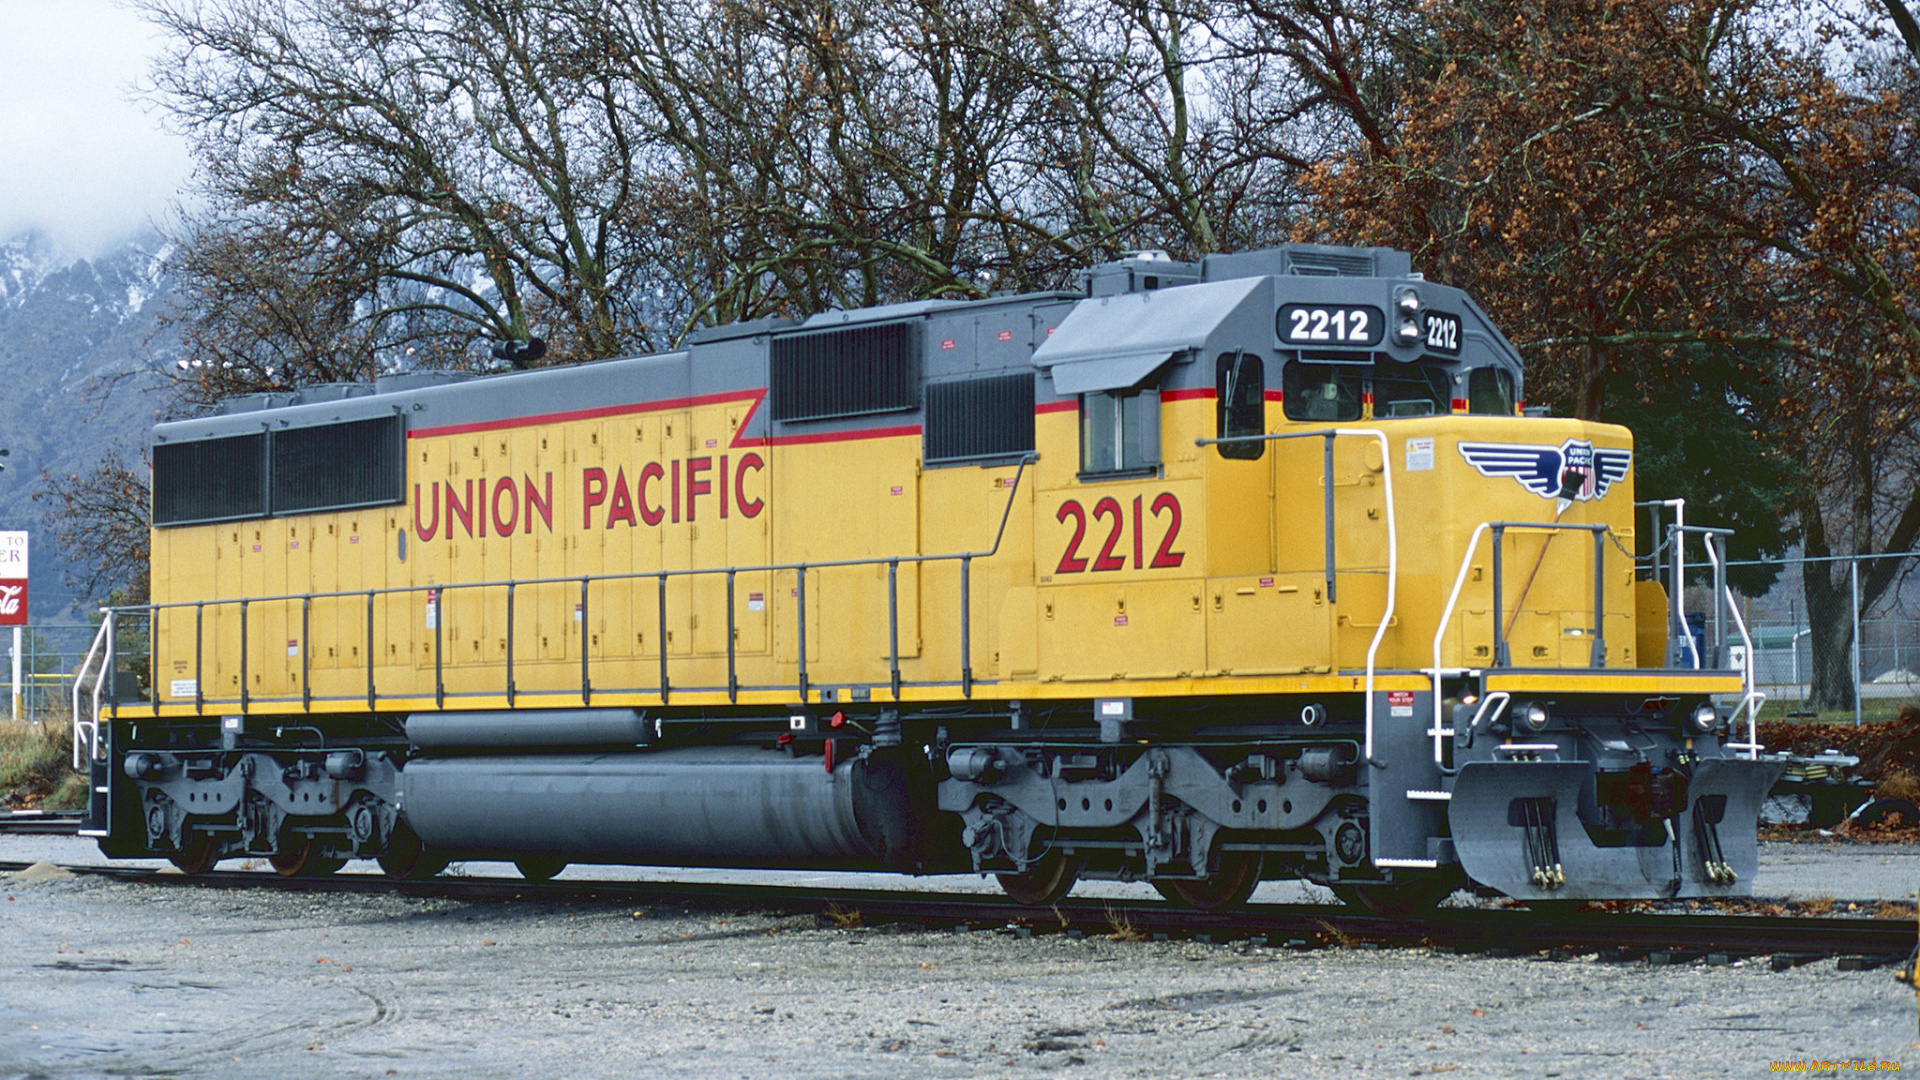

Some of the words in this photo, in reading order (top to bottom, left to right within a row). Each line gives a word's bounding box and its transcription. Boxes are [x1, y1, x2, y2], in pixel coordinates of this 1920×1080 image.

[1290, 309, 1369, 341] 2212
[1427, 316, 1457, 349] 2212
[414, 471, 553, 543] UNION
[582, 452, 765, 530] PACIFIC
[7, 536, 24, 546] TO
[1055, 491, 1186, 575] 2212
[0, 585, 23, 615] la
